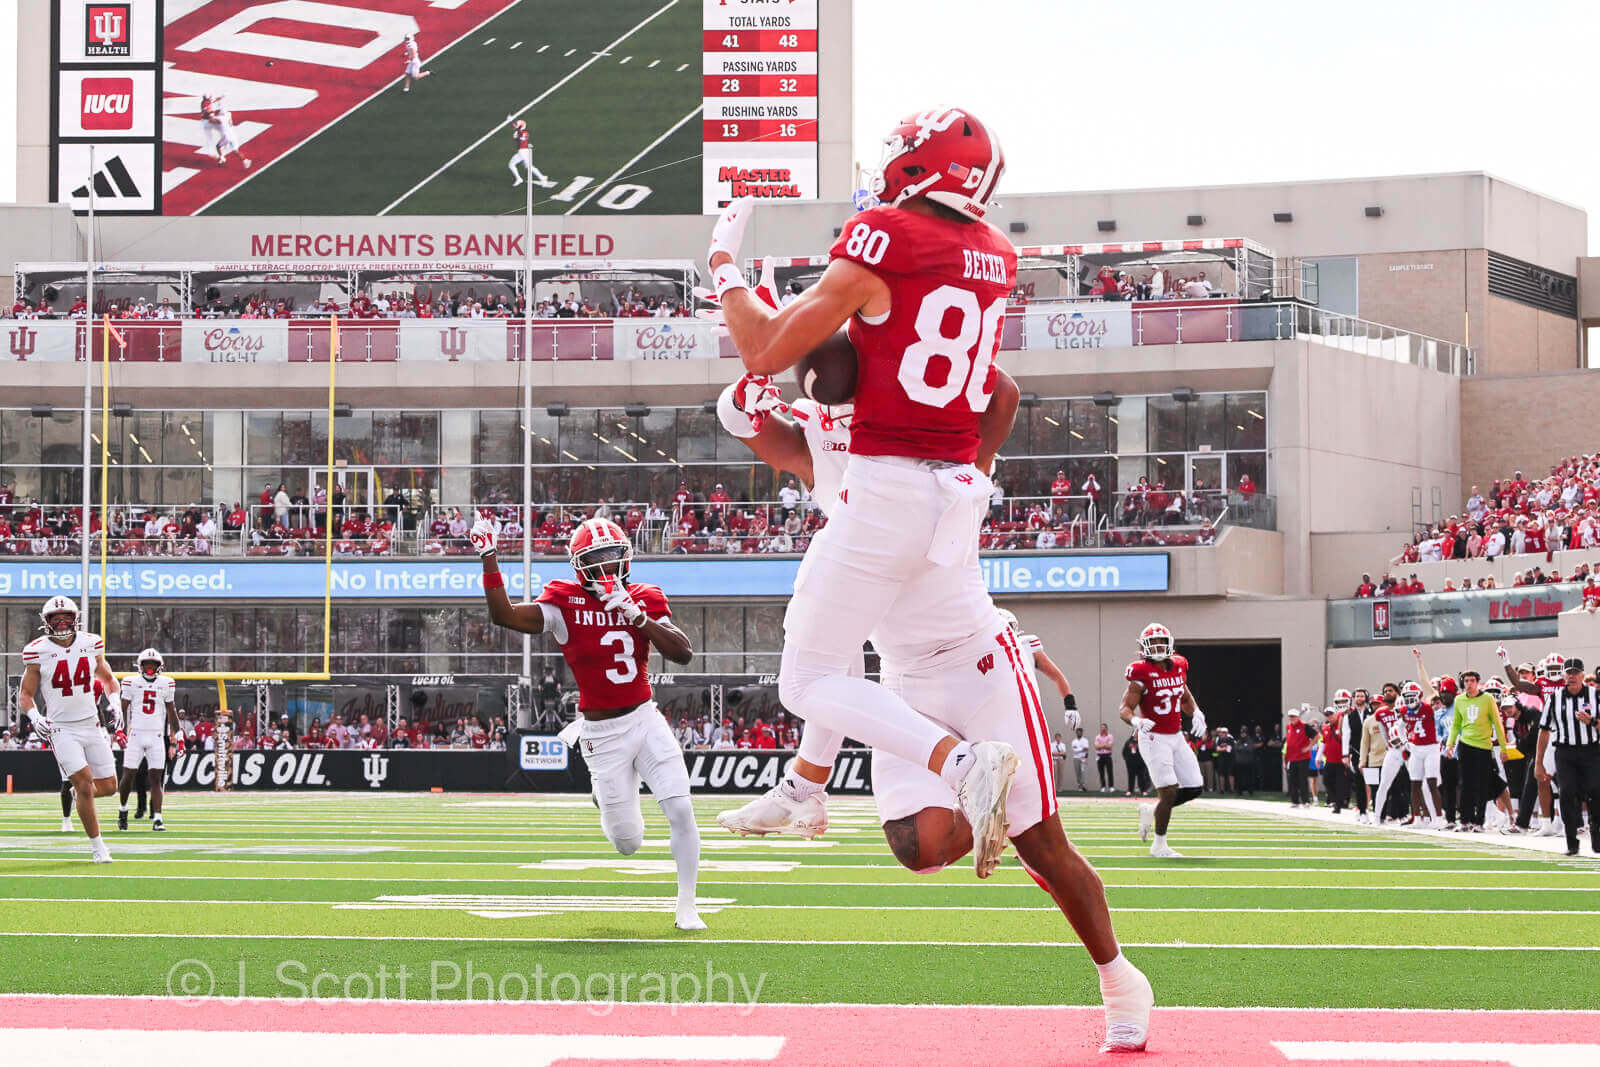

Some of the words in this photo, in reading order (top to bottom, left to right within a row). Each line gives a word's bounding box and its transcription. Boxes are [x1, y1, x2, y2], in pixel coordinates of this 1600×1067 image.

[728, 16, 758, 27] TOTAL
[759, 16, 791, 27] YARDS
[721, 34, 740, 48] 41
[778, 34, 798, 48] 48
[87, 46, 129, 55] HEALTH
[722, 61, 764, 73] PASSING
[766, 61, 798, 72] YARDS
[721, 79, 740, 93] 28
[778, 79, 798, 92] 32
[83, 93, 131, 114] IUCU
[721, 106, 765, 118] RUSHING
[766, 106, 798, 117] YARDS
[721, 124, 739, 137] 13
[779, 123, 797, 137] 16
[251, 234, 435, 257] MERCHANTS
[444, 234, 525, 256] BANK
[534, 234, 614, 256] FIELD
[845, 222, 891, 265] 80
[962, 248, 1007, 285] BECKER
[1047, 312, 1109, 337] Coors
[204, 328, 265, 351] Coors
[636, 327, 698, 350] Coors
[1055, 337, 1101, 349] LIGHT
[209, 352, 258, 363] LIGHT
[21, 569, 133, 590] Internet
[140, 569, 233, 594] Speed.
[330, 569, 367, 590] No
[575, 609, 634, 626] INDIA
[600, 630, 639, 684] 3
[51, 656, 91, 697] 44
[411, 675, 440, 685] LUCAS
[441, 674, 455, 685] OIL
[662, 674, 675, 684] OIL
[142, 690, 157, 714] 5
[1153, 685, 1185, 715] 37
[164, 753, 266, 785] UCS
